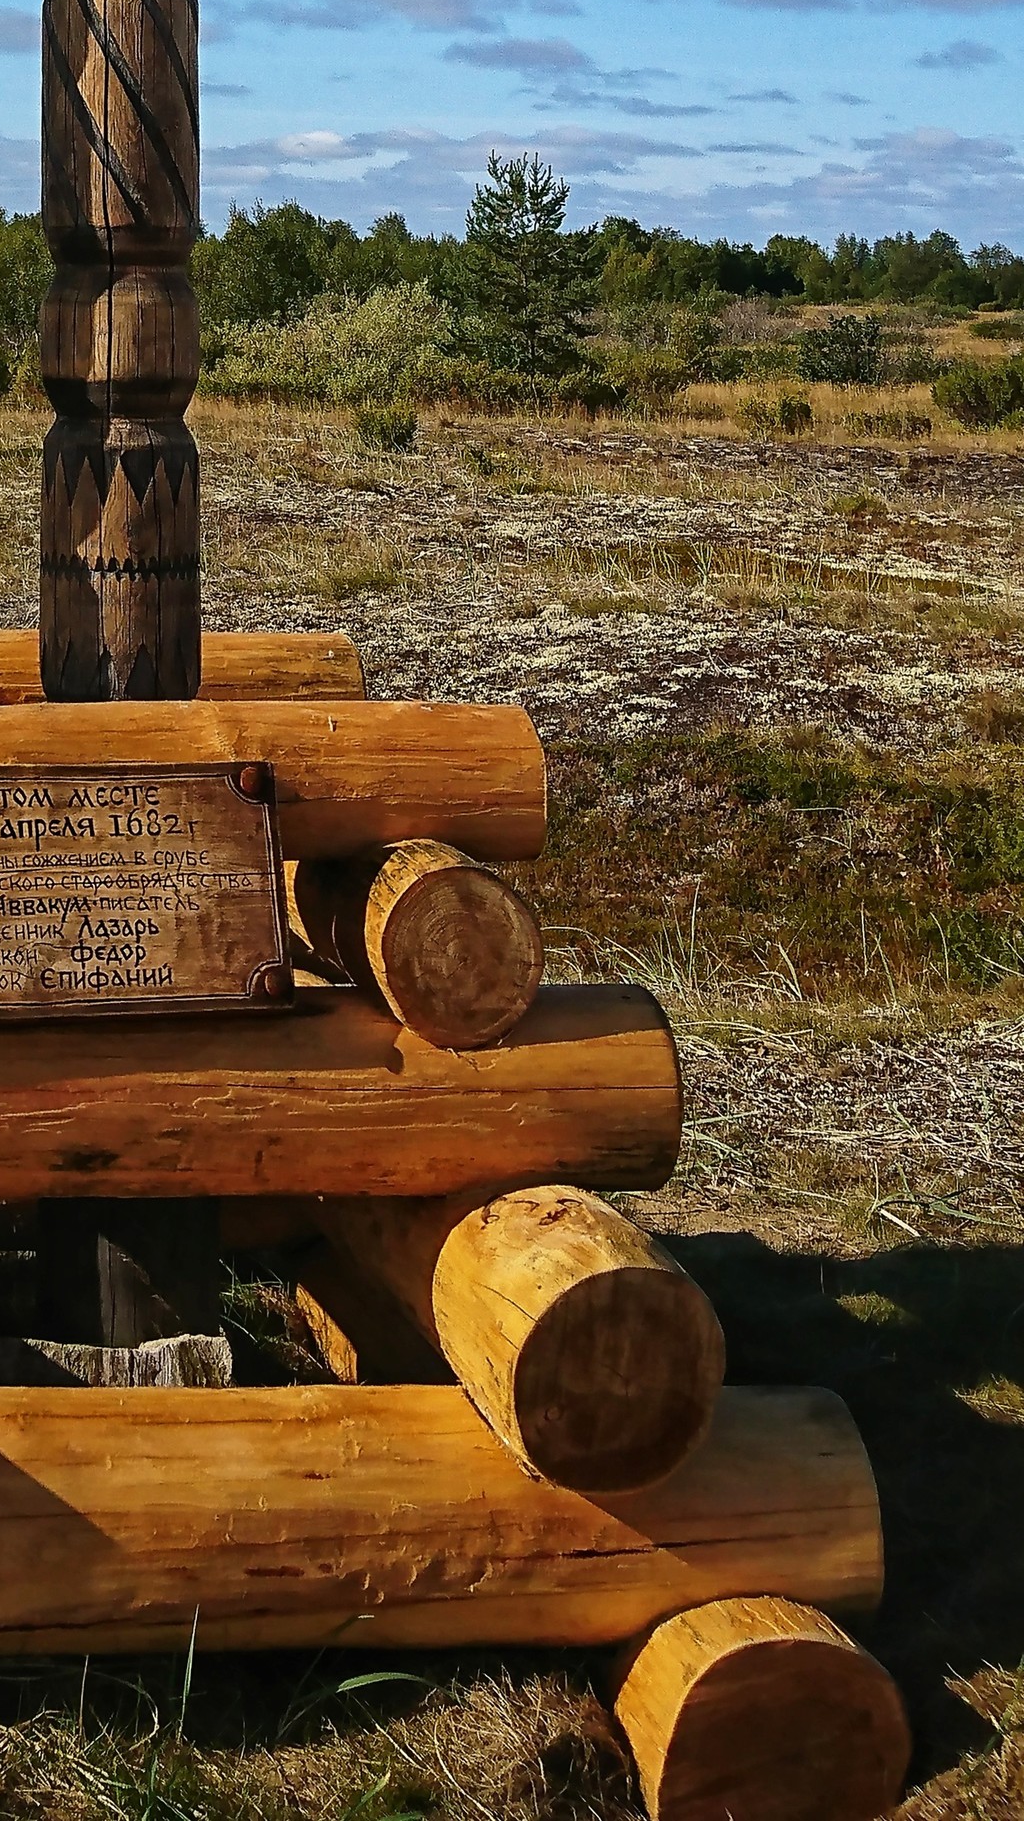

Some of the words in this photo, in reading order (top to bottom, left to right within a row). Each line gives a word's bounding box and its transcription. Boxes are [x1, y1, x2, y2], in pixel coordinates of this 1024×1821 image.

[67, 785, 160, 808] МЕСТЕ
[78, 915, 160, 942] Лазарь
[40, 963, 173, 993] Епифаний
